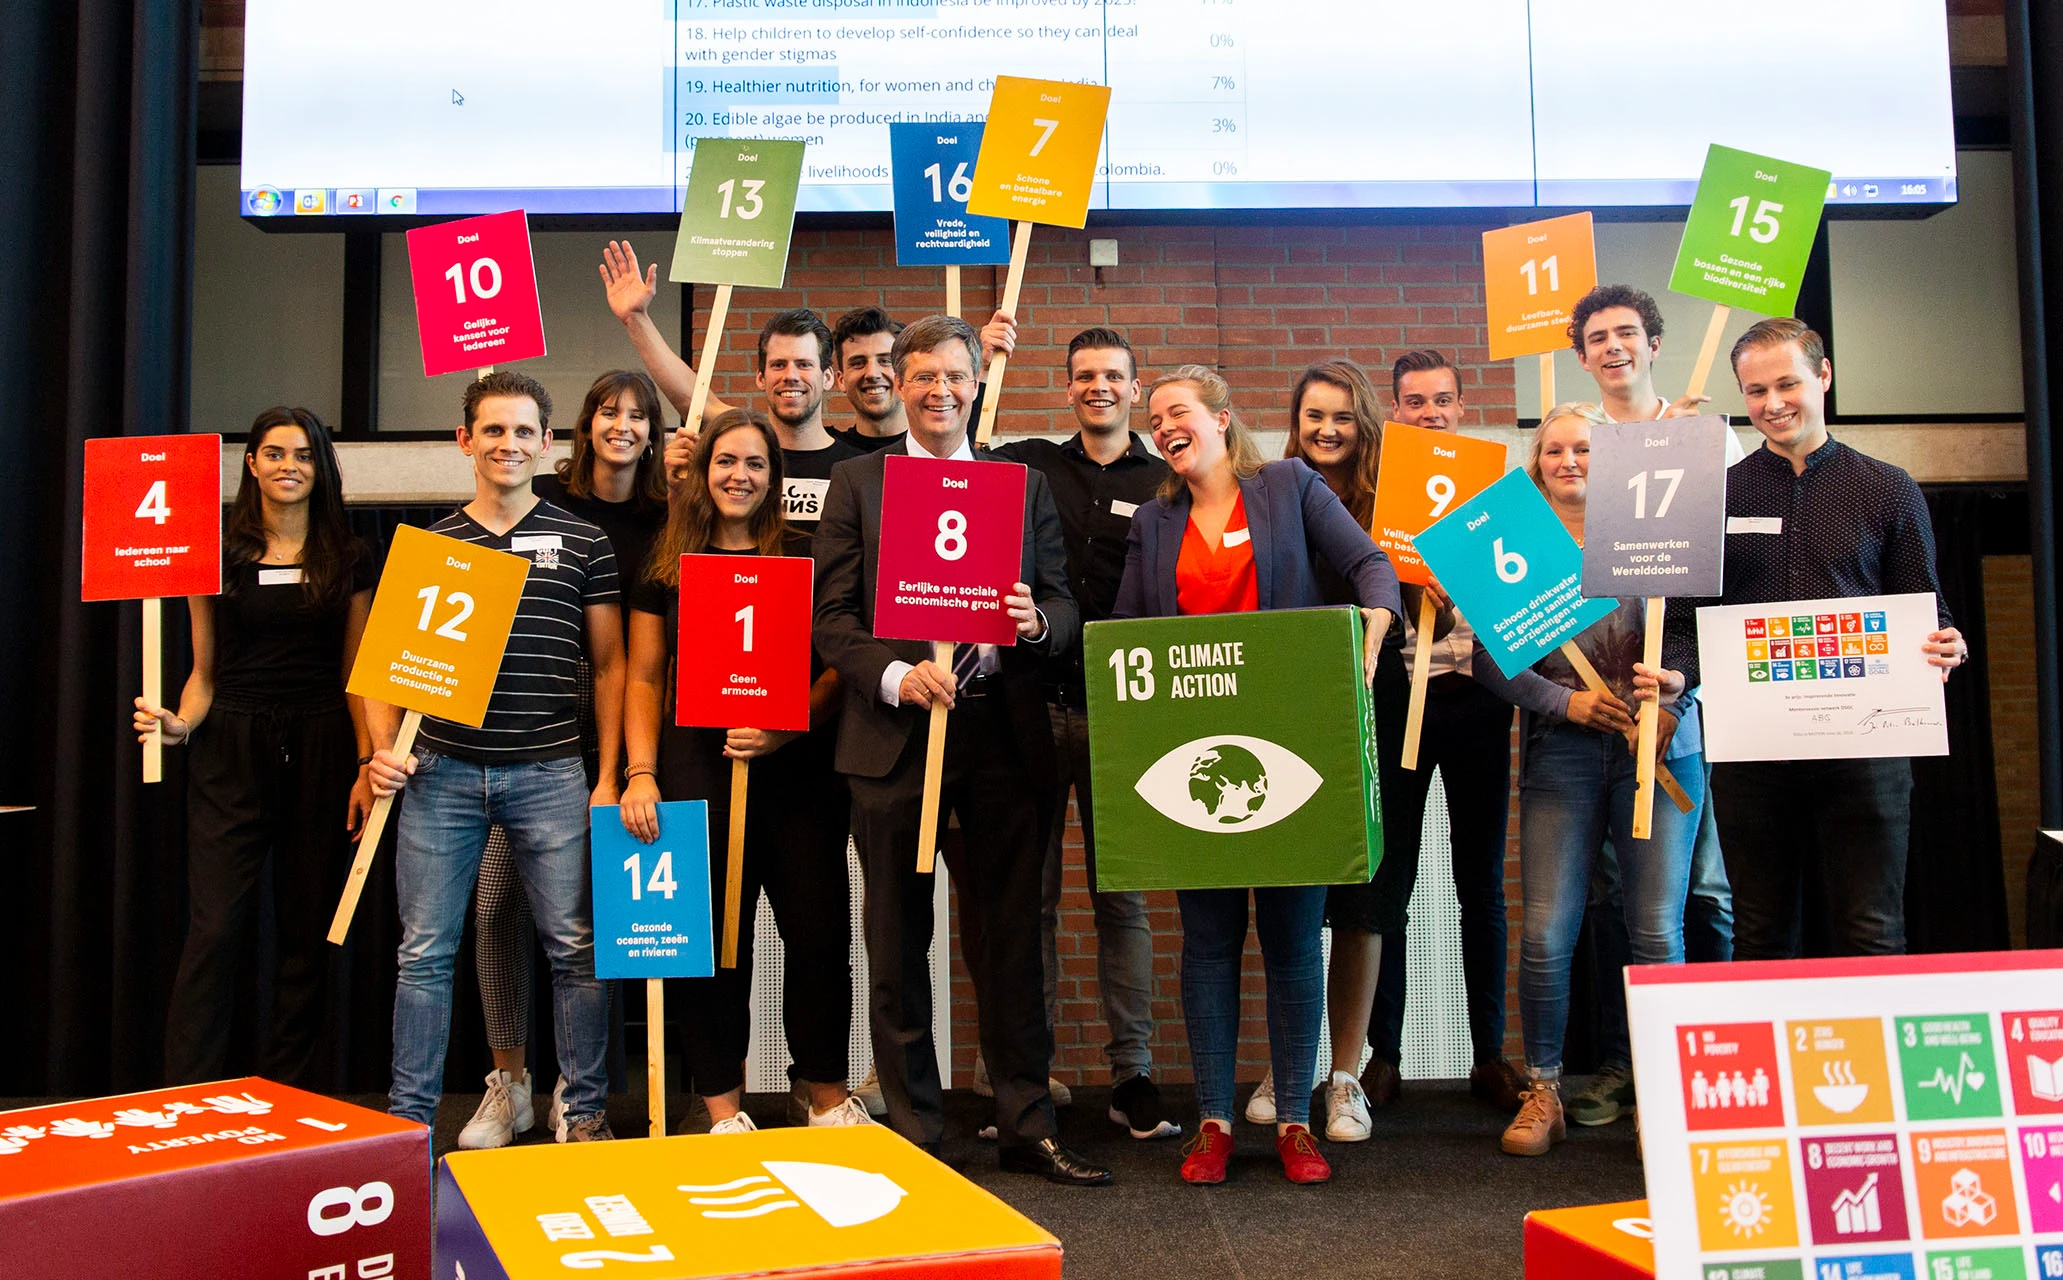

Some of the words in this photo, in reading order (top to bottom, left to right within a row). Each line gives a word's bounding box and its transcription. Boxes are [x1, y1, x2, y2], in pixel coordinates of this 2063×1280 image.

[713, 0, 760, 8] Plastic
[765, 0, 807, 8] waste
[812, 0, 873, 10] disposal
[686, 28, 708, 40] 18.
[713, 28, 747, 42] Help
[752, 27, 812, 40] children
[817, 28, 831, 40] to
[836, 27, 895, 42] develop
[900, 26, 1012, 39] self-confidence
[1018, 29, 1034, 38] so
[1039, 26, 1070, 41] they
[1075, 28, 1100, 38] can
[1107, 25, 1138, 37] deal
[1210, 33, 1234, 47] 0%
[685, 49, 717, 60] with
[722, 49, 774, 64] gender
[780, 49, 837, 64] stigmas
[686, 81, 707, 93] 19.
[713, 80, 781, 92] Healthier
[786, 80, 854, 94] nutrition,
[860, 79, 880, 92] for
[885, 81, 941, 92] women
[945, 79, 974, 92] and
[1212, 76, 1236, 90] 7%
[1040, 94, 1062, 104] Doel
[685, 112, 707, 126] 20.
[713, 112, 758, 126] Edible
[762, 112, 802, 128] algae
[806, 112, 825, 125] be
[830, 112, 901, 128] produced
[906, 112, 920, 122] in
[925, 111, 961, 122] India
[1212, 118, 1236, 133] 3%
[937, 136, 958, 144] Doel
[1029, 118, 1060, 157] 7
[738, 154, 758, 162] Doel
[808, 165, 889, 178] livelihoods
[1095, 164, 1166, 176] olombia.
[1213, 161, 1238, 176] 0%
[1755, 170, 1778, 182] Doel
[924, 162, 973, 202] 16
[1016, 174, 1050, 185] Schone
[1000, 183, 1011, 191] en
[1014, 184, 1063, 197] betaalbare
[1902, 184, 1927, 195] 16:05
[717, 179, 766, 220] 13
[1012, 194, 1046, 206] energie
[936, 219, 966, 228] Vrede,
[1729, 196, 1784, 244] 15
[458, 232, 479, 244] Doel
[925, 229, 967, 239] veiligheid
[968, 230, 980, 238] en
[1528, 234, 1547, 244] Doel
[691, 236, 775, 250] Klimaatverandering
[916, 239, 990, 250] rechtvaardigheid
[712, 248, 748, 258] stoppen
[1720, 254, 1762, 271] Gezonde
[445, 258, 502, 304] 10
[1520, 256, 1559, 296] 11
[1694, 258, 1728, 274] bossen
[1730, 269, 1742, 278] en
[1744, 273, 1760, 283] een
[1763, 276, 1786, 289] rijke
[1704, 272, 1767, 296] biodiversiteit
[1522, 309, 1563, 320] Leefbare,
[464, 318, 496, 330] Gelijke
[1506, 320, 1549, 332] duurzame
[453, 330, 486, 342] kansen
[488, 326, 510, 336] voor
[464, 338, 505, 351] iedereen
[1644, 437, 1669, 448] Doel
[141, 452, 166, 462] Doel
[1434, 446, 1456, 459] Doel
[942, 477, 968, 489] Doel
[1426, 474, 1456, 518] 9
[1628, 468, 1685, 519] 17
[135, 480, 171, 524] 4
[1466, 511, 1490, 532] Doel
[934, 510, 968, 560] 8
[115, 547, 163, 557] Iedereen
[166, 546, 190, 554] naar
[1380, 540, 1392, 548] en
[1613, 540, 1690, 551] Samenwerken
[134, 557, 170, 567] school
[446, 556, 472, 572] Doel
[1398, 554, 1421, 565] voor
[1493, 536, 1528, 584] 6
[1630, 554, 1654, 563] voor
[1657, 552, 1672, 562] de
[1612, 565, 1688, 576] Werelddoelen
[734, 574, 758, 584] Doel
[898, 581, 940, 594] Eerlijke
[942, 585, 956, 594] en
[959, 586, 998, 597] sociale
[894, 595, 969, 608] economische
[971, 600, 1000, 611] groei
[1494, 607, 1529, 633] Schoon
[1529, 573, 1578, 610] drinkwater
[417, 584, 475, 642] 12
[735, 605, 754, 652] 1
[1502, 630, 1516, 642] en
[1516, 611, 1544, 634] goede
[1507, 607, 1571, 653] voorzieningen
[402, 649, 455, 673] Duurzame
[390, 661, 442, 682] productie
[445, 676, 458, 686] en
[730, 673, 756, 684] Geen
[1108, 647, 1156, 702] 13
[1168, 642, 1244, 669] CLIMATE
[390, 673, 452, 698] consumptie
[722, 686, 768, 696] armoede
[1170, 672, 1238, 699] ACTION
[623, 852, 678, 900] 14
[631, 922, 672, 932] Gezonde
[616, 936, 659, 946] oceanen,
[661, 934, 689, 944] zeeën
[628, 948, 640, 957] en
[642, 947, 678, 957] rivieren
[1902, 1022, 1917, 1048] 3
[2011, 1018, 2024, 1043] 4
[1686, 1031, 1697, 1057] 1
[1794, 1026, 1808, 1052] 2
[296, 1117, 348, 1132] 1
[127, 1126, 266, 1154] POVERTY
[237, 1132, 286, 1144] NO
[2024, 1132, 2047, 1159] 10
[1808, 1143, 1823, 1170] 8
[1917, 1138, 1932, 1164] 9
[1698, 1149, 1710, 1175] 7
[308, 1181, 394, 1236] 8
[584, 1194, 655, 1237] HUNGER
[536, 1212, 595, 1242] ZERO
[560, 1244, 675, 1268] 2
[2042, 1250, 2063, 1278] 16
[1932, 1256, 1954, 1280] 15
